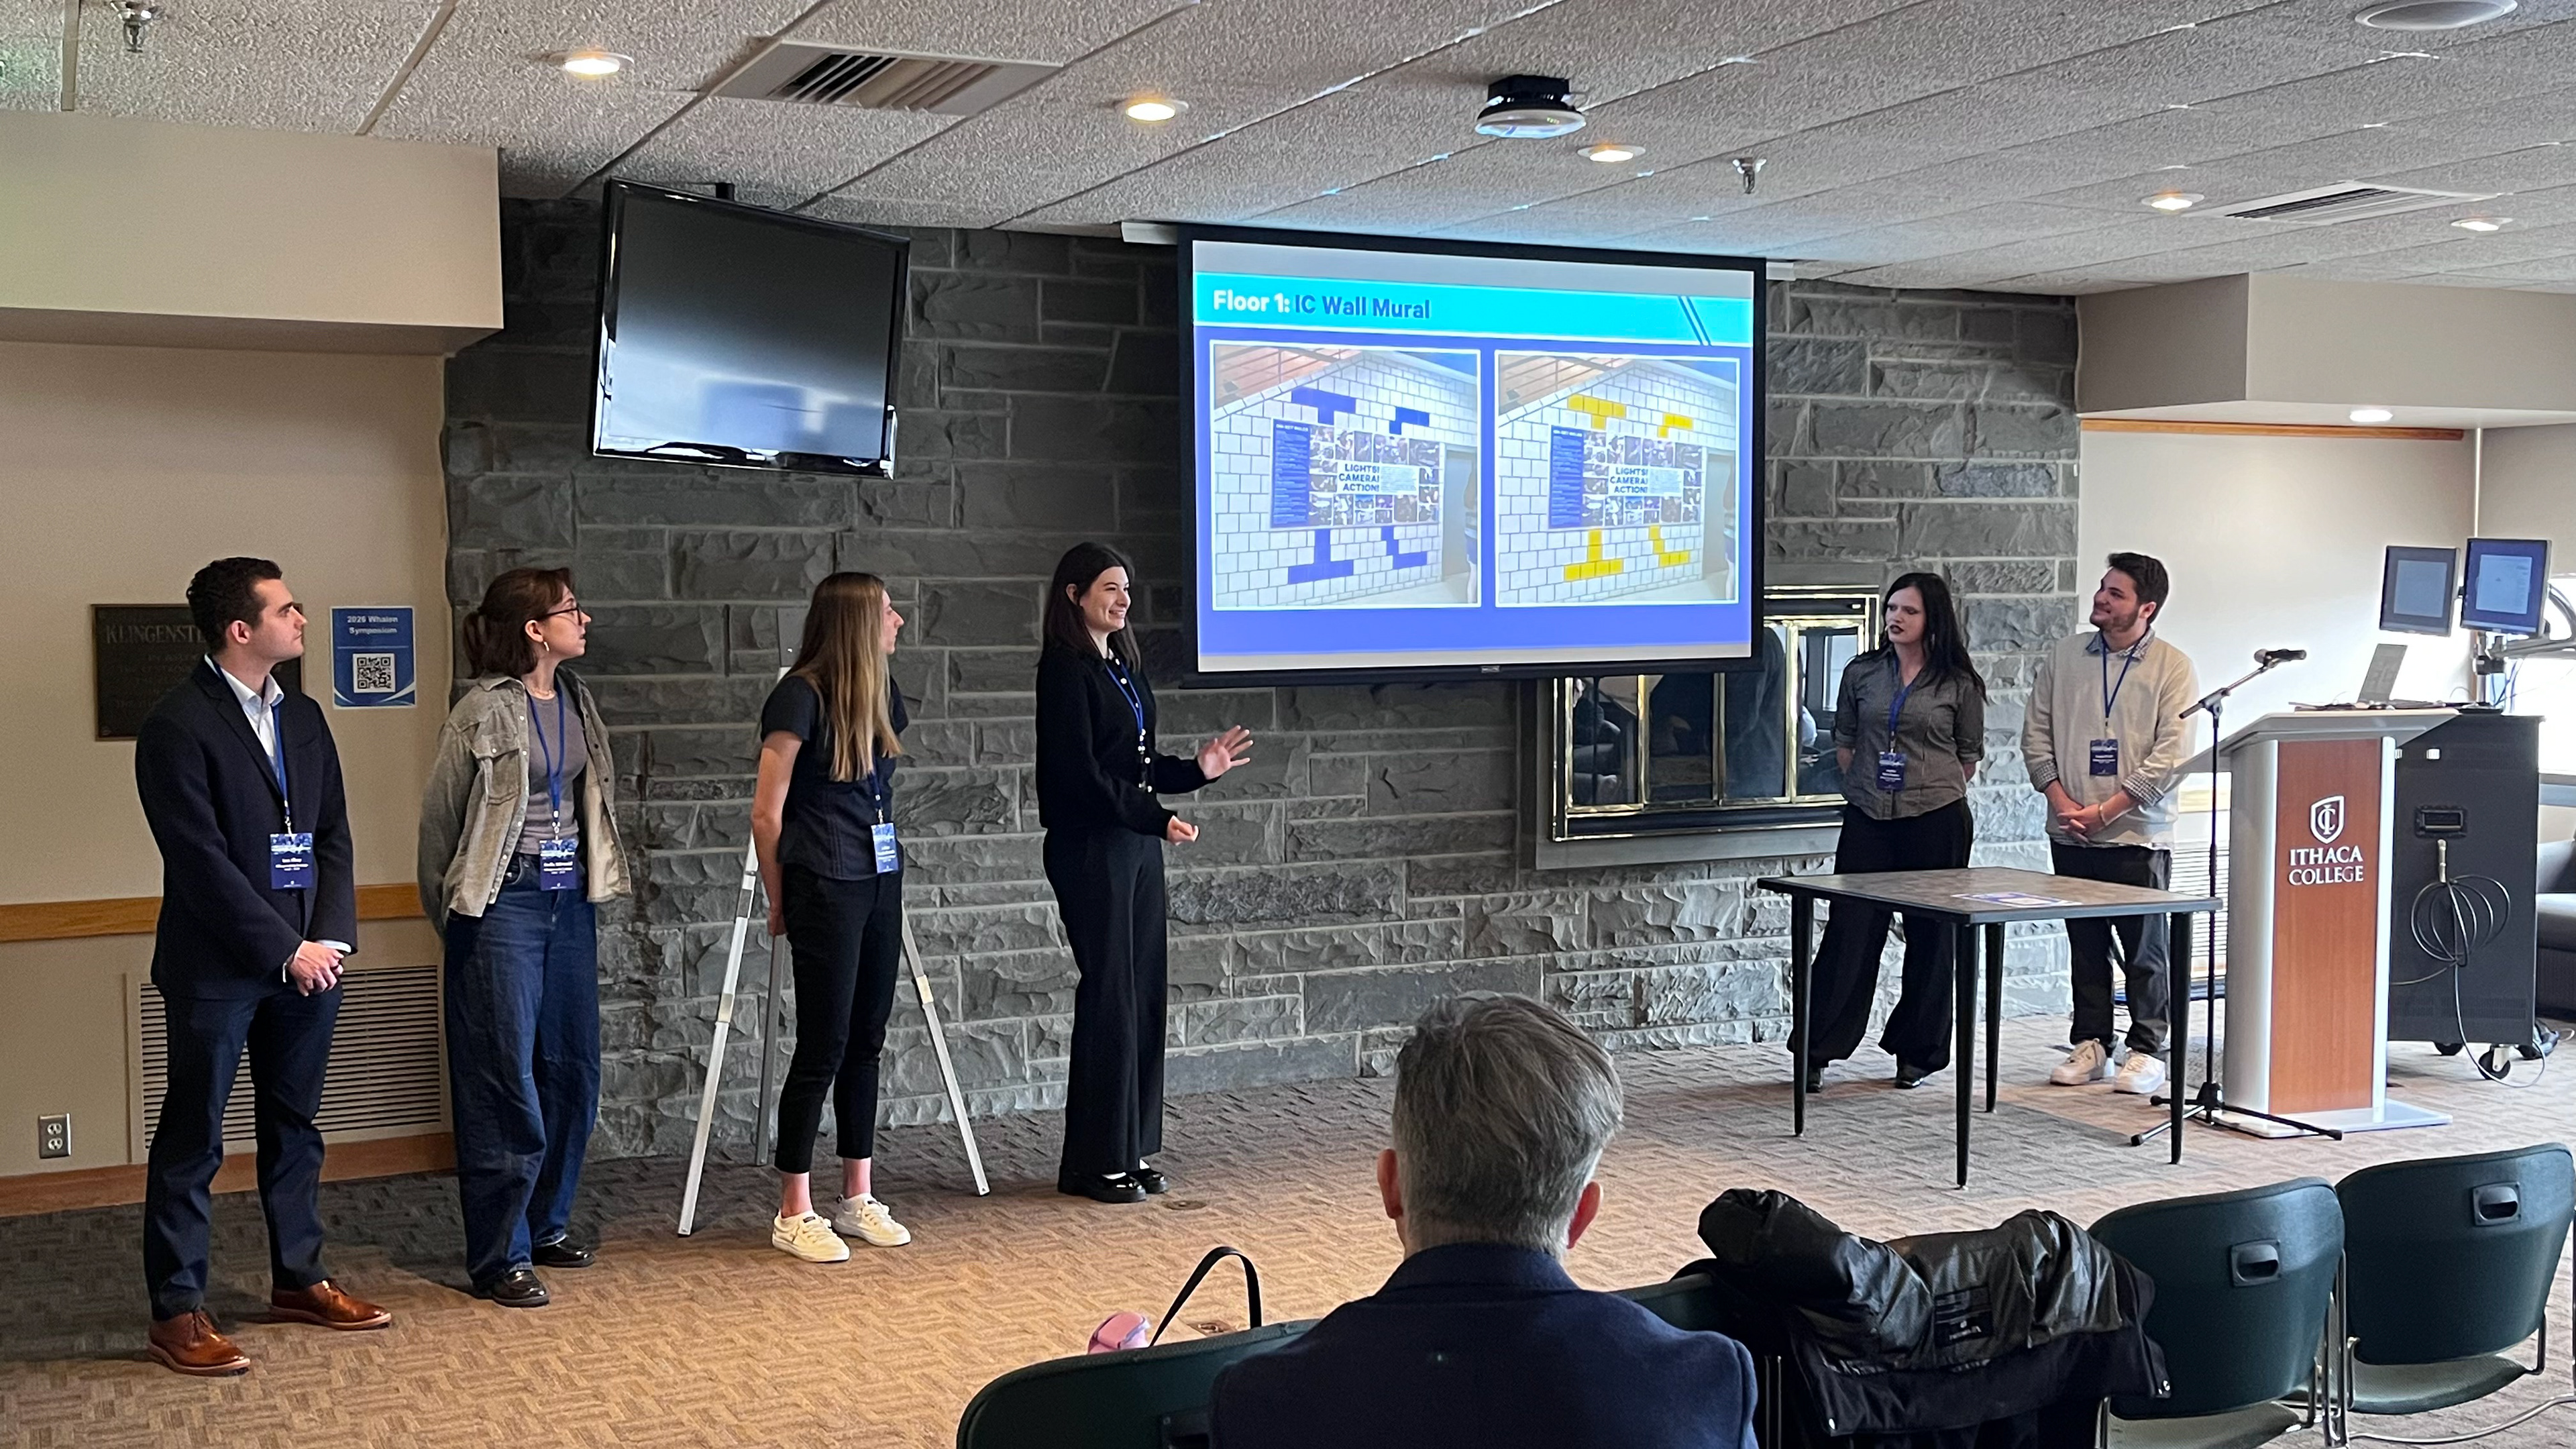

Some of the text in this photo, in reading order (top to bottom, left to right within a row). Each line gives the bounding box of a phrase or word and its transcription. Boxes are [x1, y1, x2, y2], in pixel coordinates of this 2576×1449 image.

[1213, 289, 1430, 319] Floor 1: IC Wall Mural
[1344, 464, 1380, 474] LIGHTS!
[1338, 473, 1380, 482] CAMERA!
[1343, 483, 1379, 492] ACTION!
[1614, 486, 1648, 494] ACTION!
[2290, 845, 2364, 866] ITHACA
[2288, 865, 2364, 885] COLLEGE
